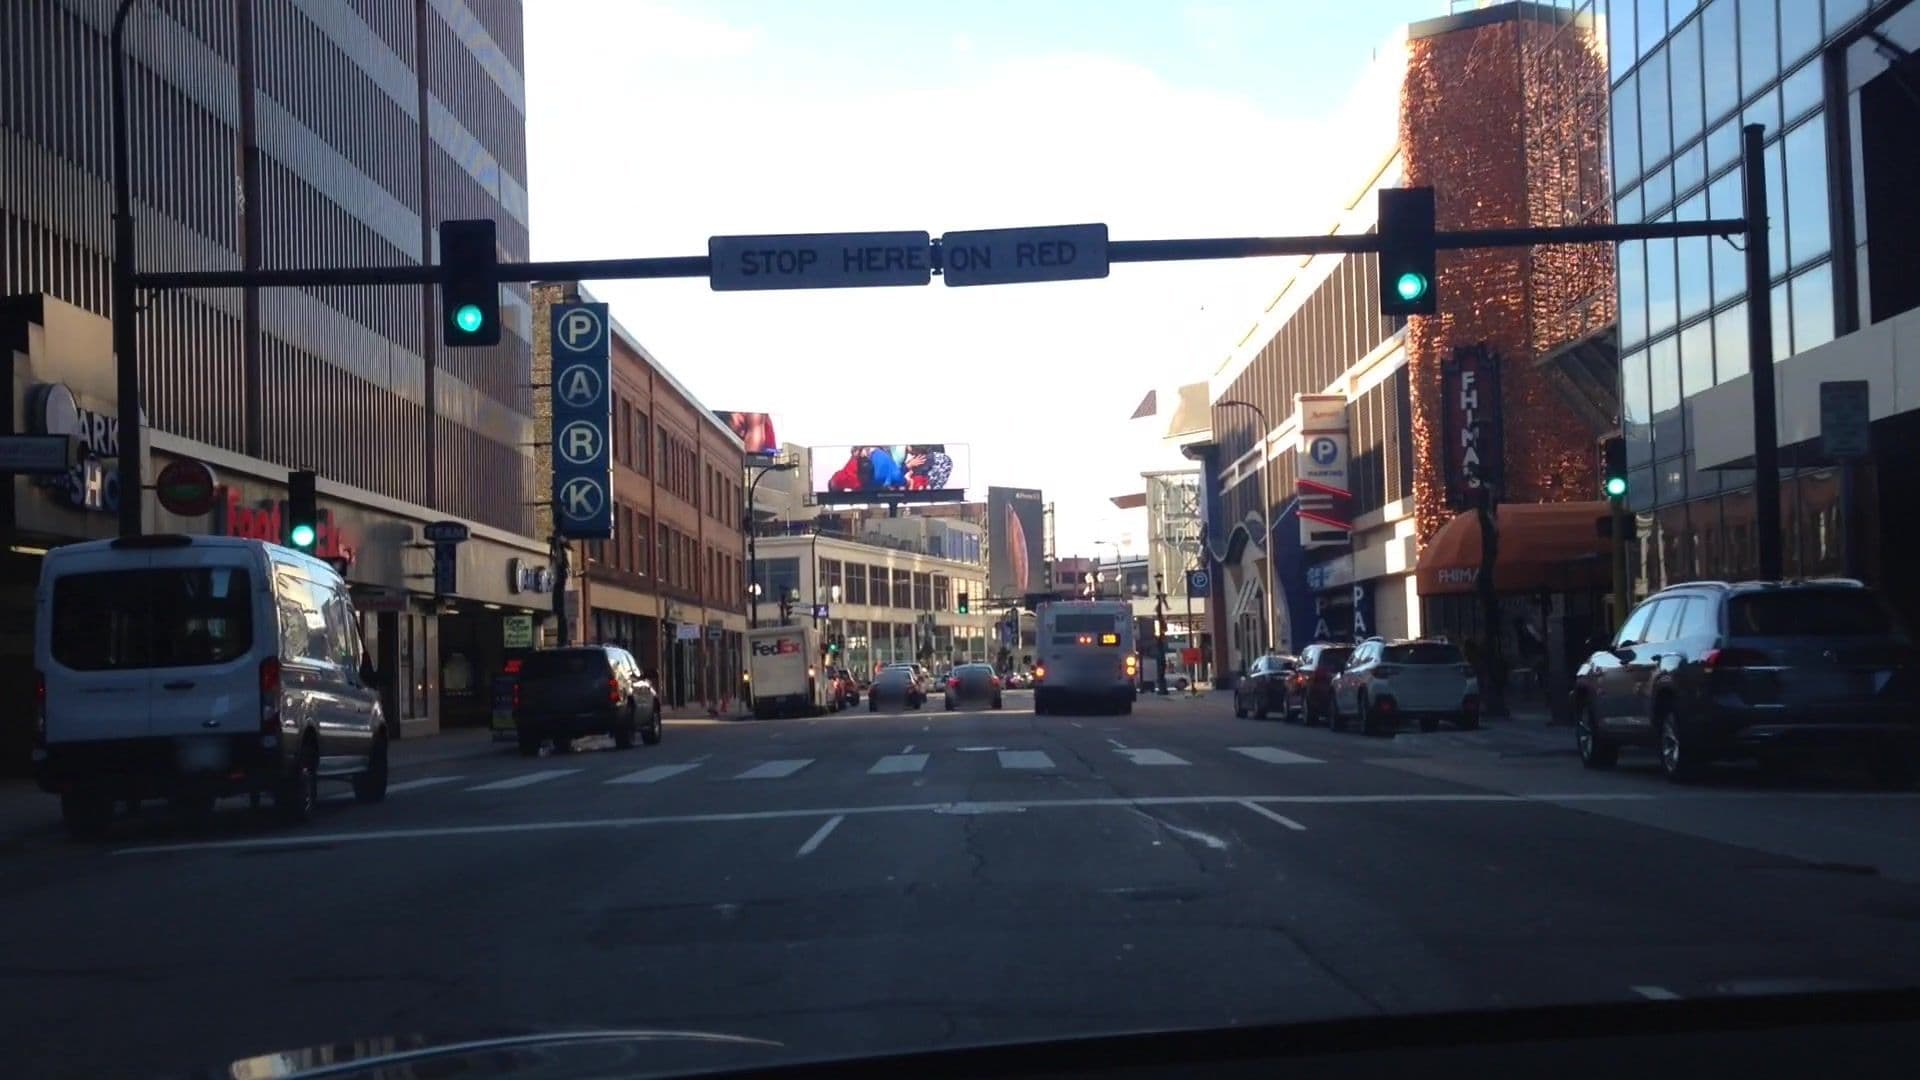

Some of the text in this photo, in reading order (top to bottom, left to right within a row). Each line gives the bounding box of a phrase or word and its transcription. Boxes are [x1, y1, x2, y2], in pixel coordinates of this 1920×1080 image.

[741, 246, 927, 275] STOP HERE
[949, 240, 1077, 271] ON RED
[567, 313, 594, 514] PARK
[1317, 441, 1334, 461] P
[752, 640, 800, 656] FedEx
